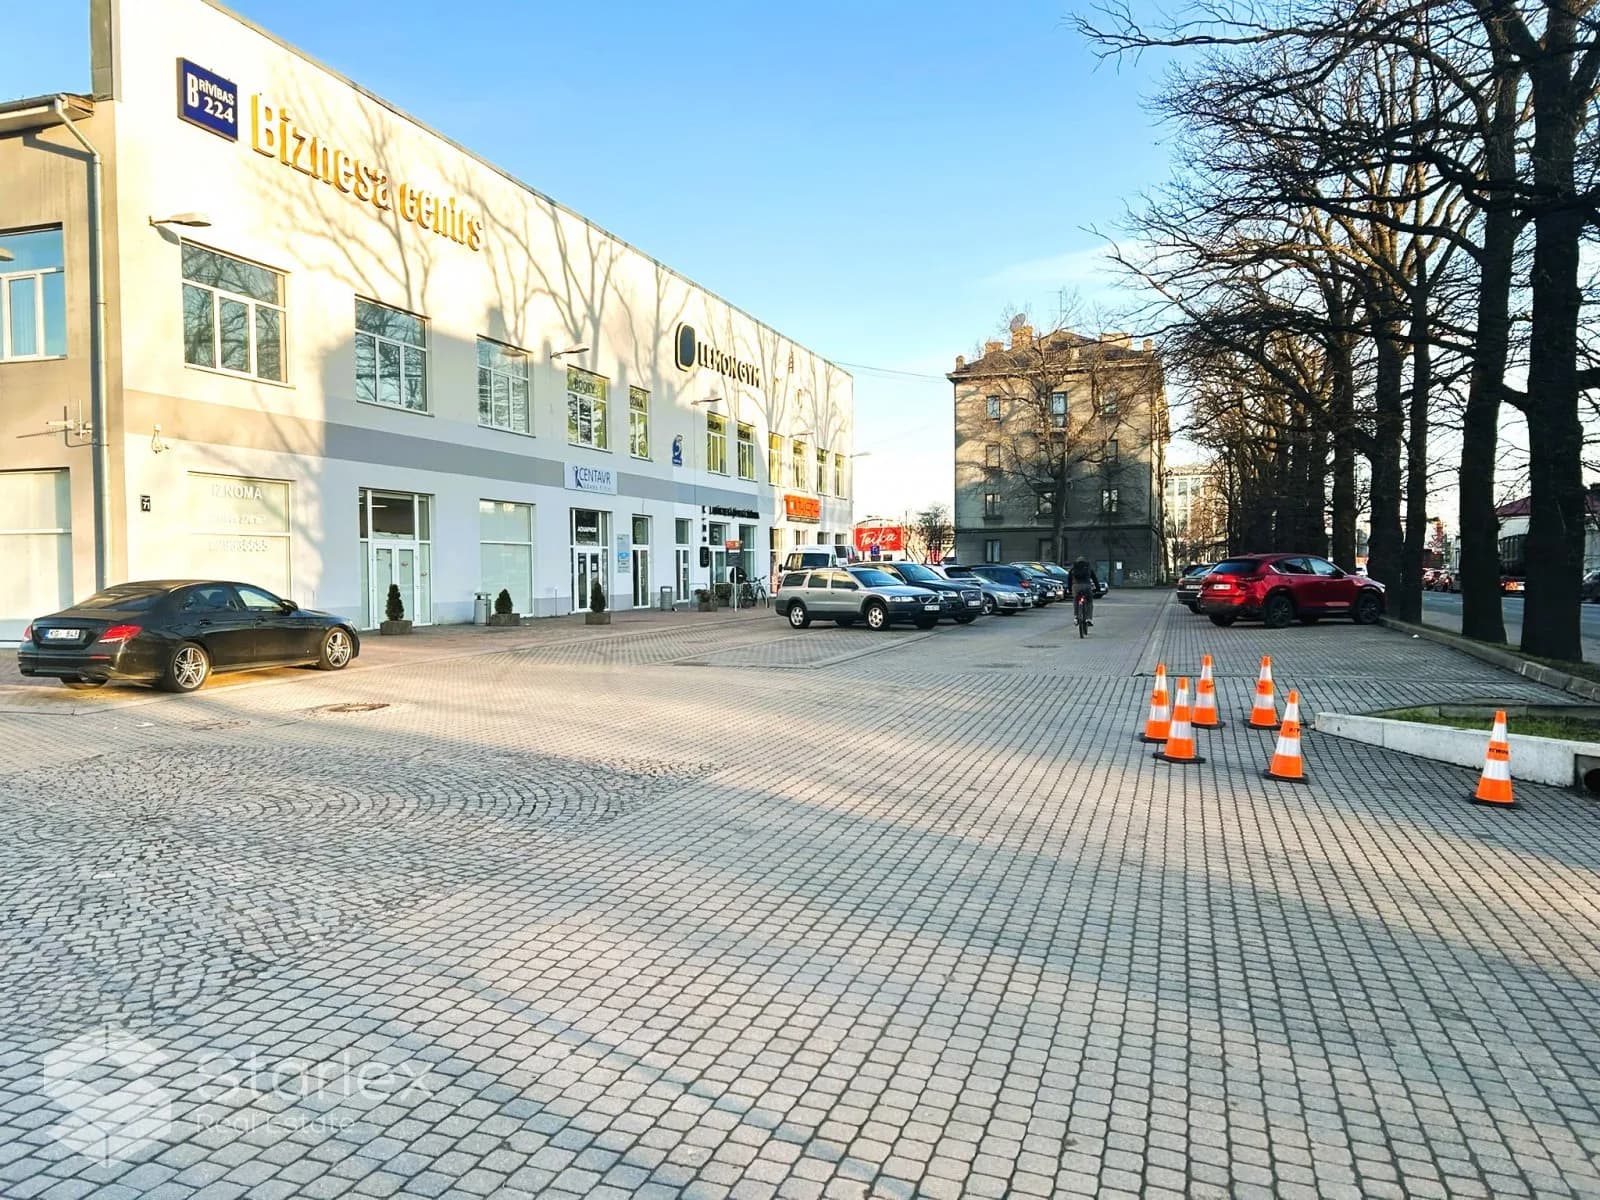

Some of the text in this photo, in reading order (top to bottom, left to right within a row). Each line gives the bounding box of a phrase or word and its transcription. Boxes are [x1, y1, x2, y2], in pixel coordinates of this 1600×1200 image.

[204, 96, 234, 124] 224
[252, 93, 482, 252] Biznesa centrs
